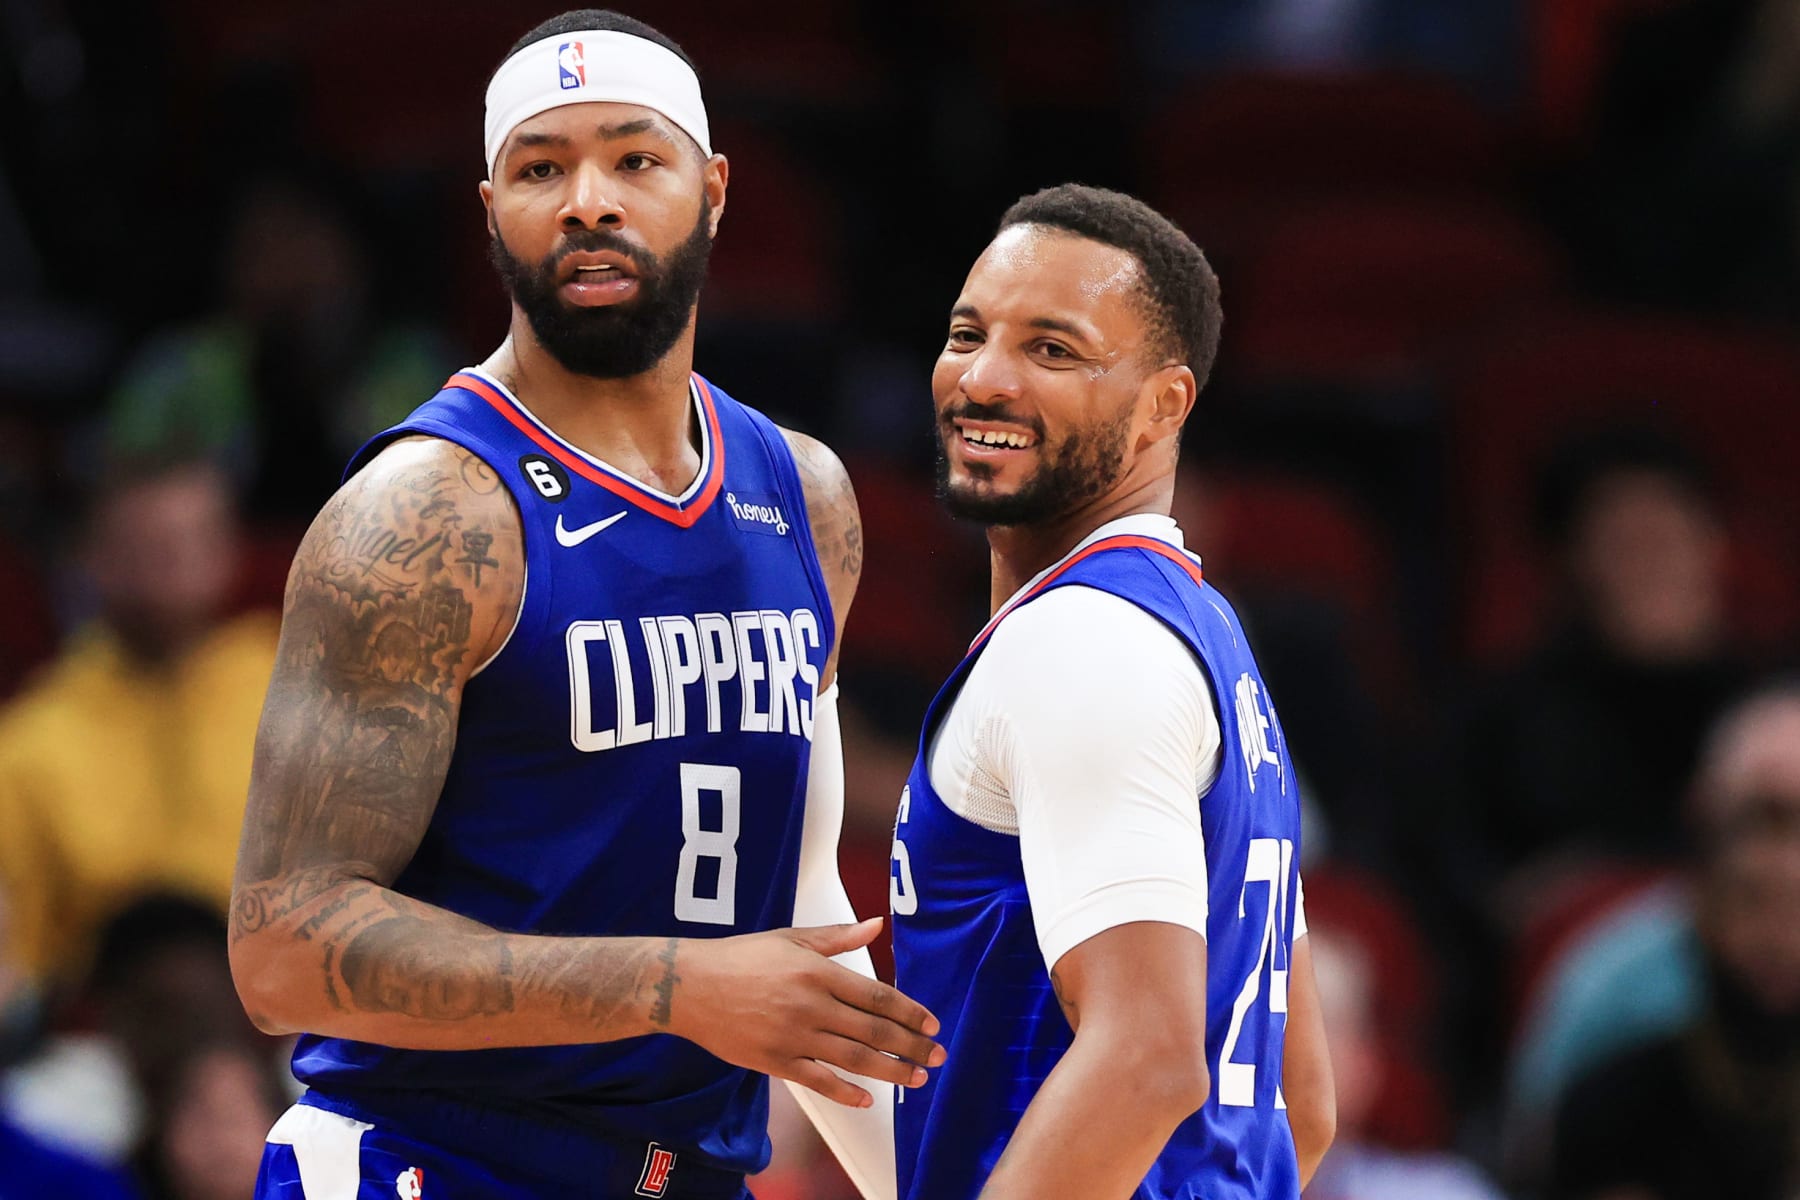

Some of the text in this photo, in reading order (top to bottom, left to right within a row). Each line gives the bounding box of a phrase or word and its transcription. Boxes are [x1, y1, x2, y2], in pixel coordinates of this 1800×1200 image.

[525, 460, 562, 497] 6
[726, 492, 790, 535] honey
[565, 608, 820, 752] CLIPPERS
[674, 762, 741, 926] 8
